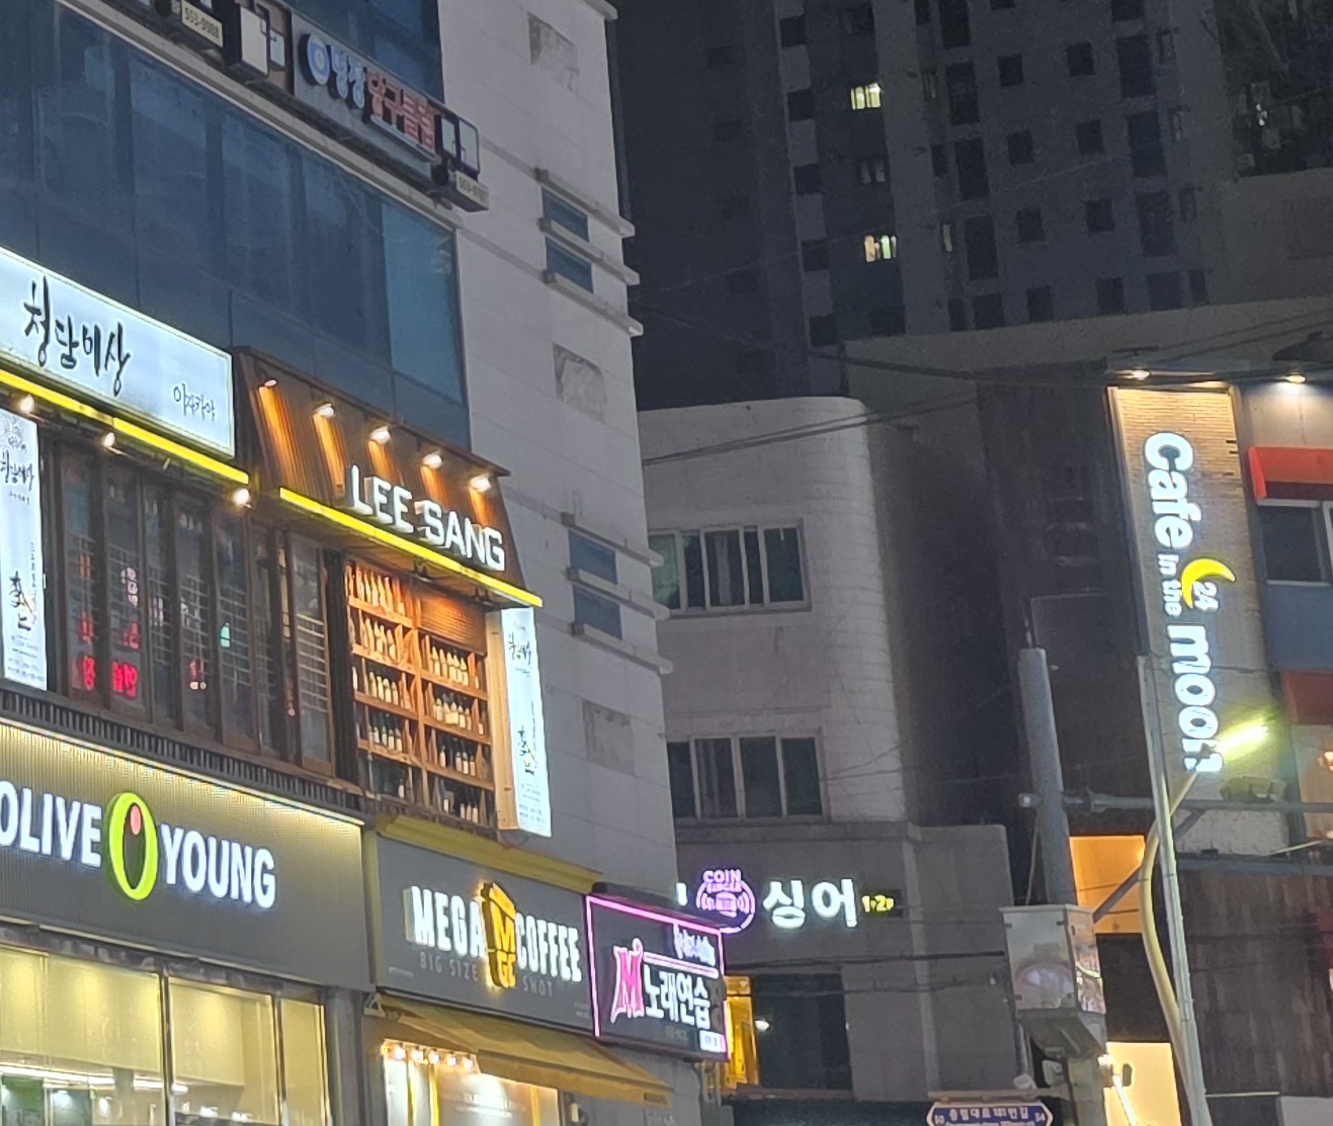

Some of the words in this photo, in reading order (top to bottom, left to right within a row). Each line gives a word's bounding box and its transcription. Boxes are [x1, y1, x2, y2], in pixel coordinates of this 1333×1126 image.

[349, 464, 414, 534] LEE
[415, 499, 506, 572] SANG
[1191, 581, 1220, 612] 24
[161, 824, 277, 910] YOUNG
[702, 868, 742, 883] COIN
[762, 878, 859, 929] 싱어
[405, 884, 483, 959] MEGA
[514, 912, 582, 983] COFFEE
[419, 951, 443, 974] BIG
[449, 958, 479, 982] SIZE
[643, 963, 724, 1030] 노래연습
